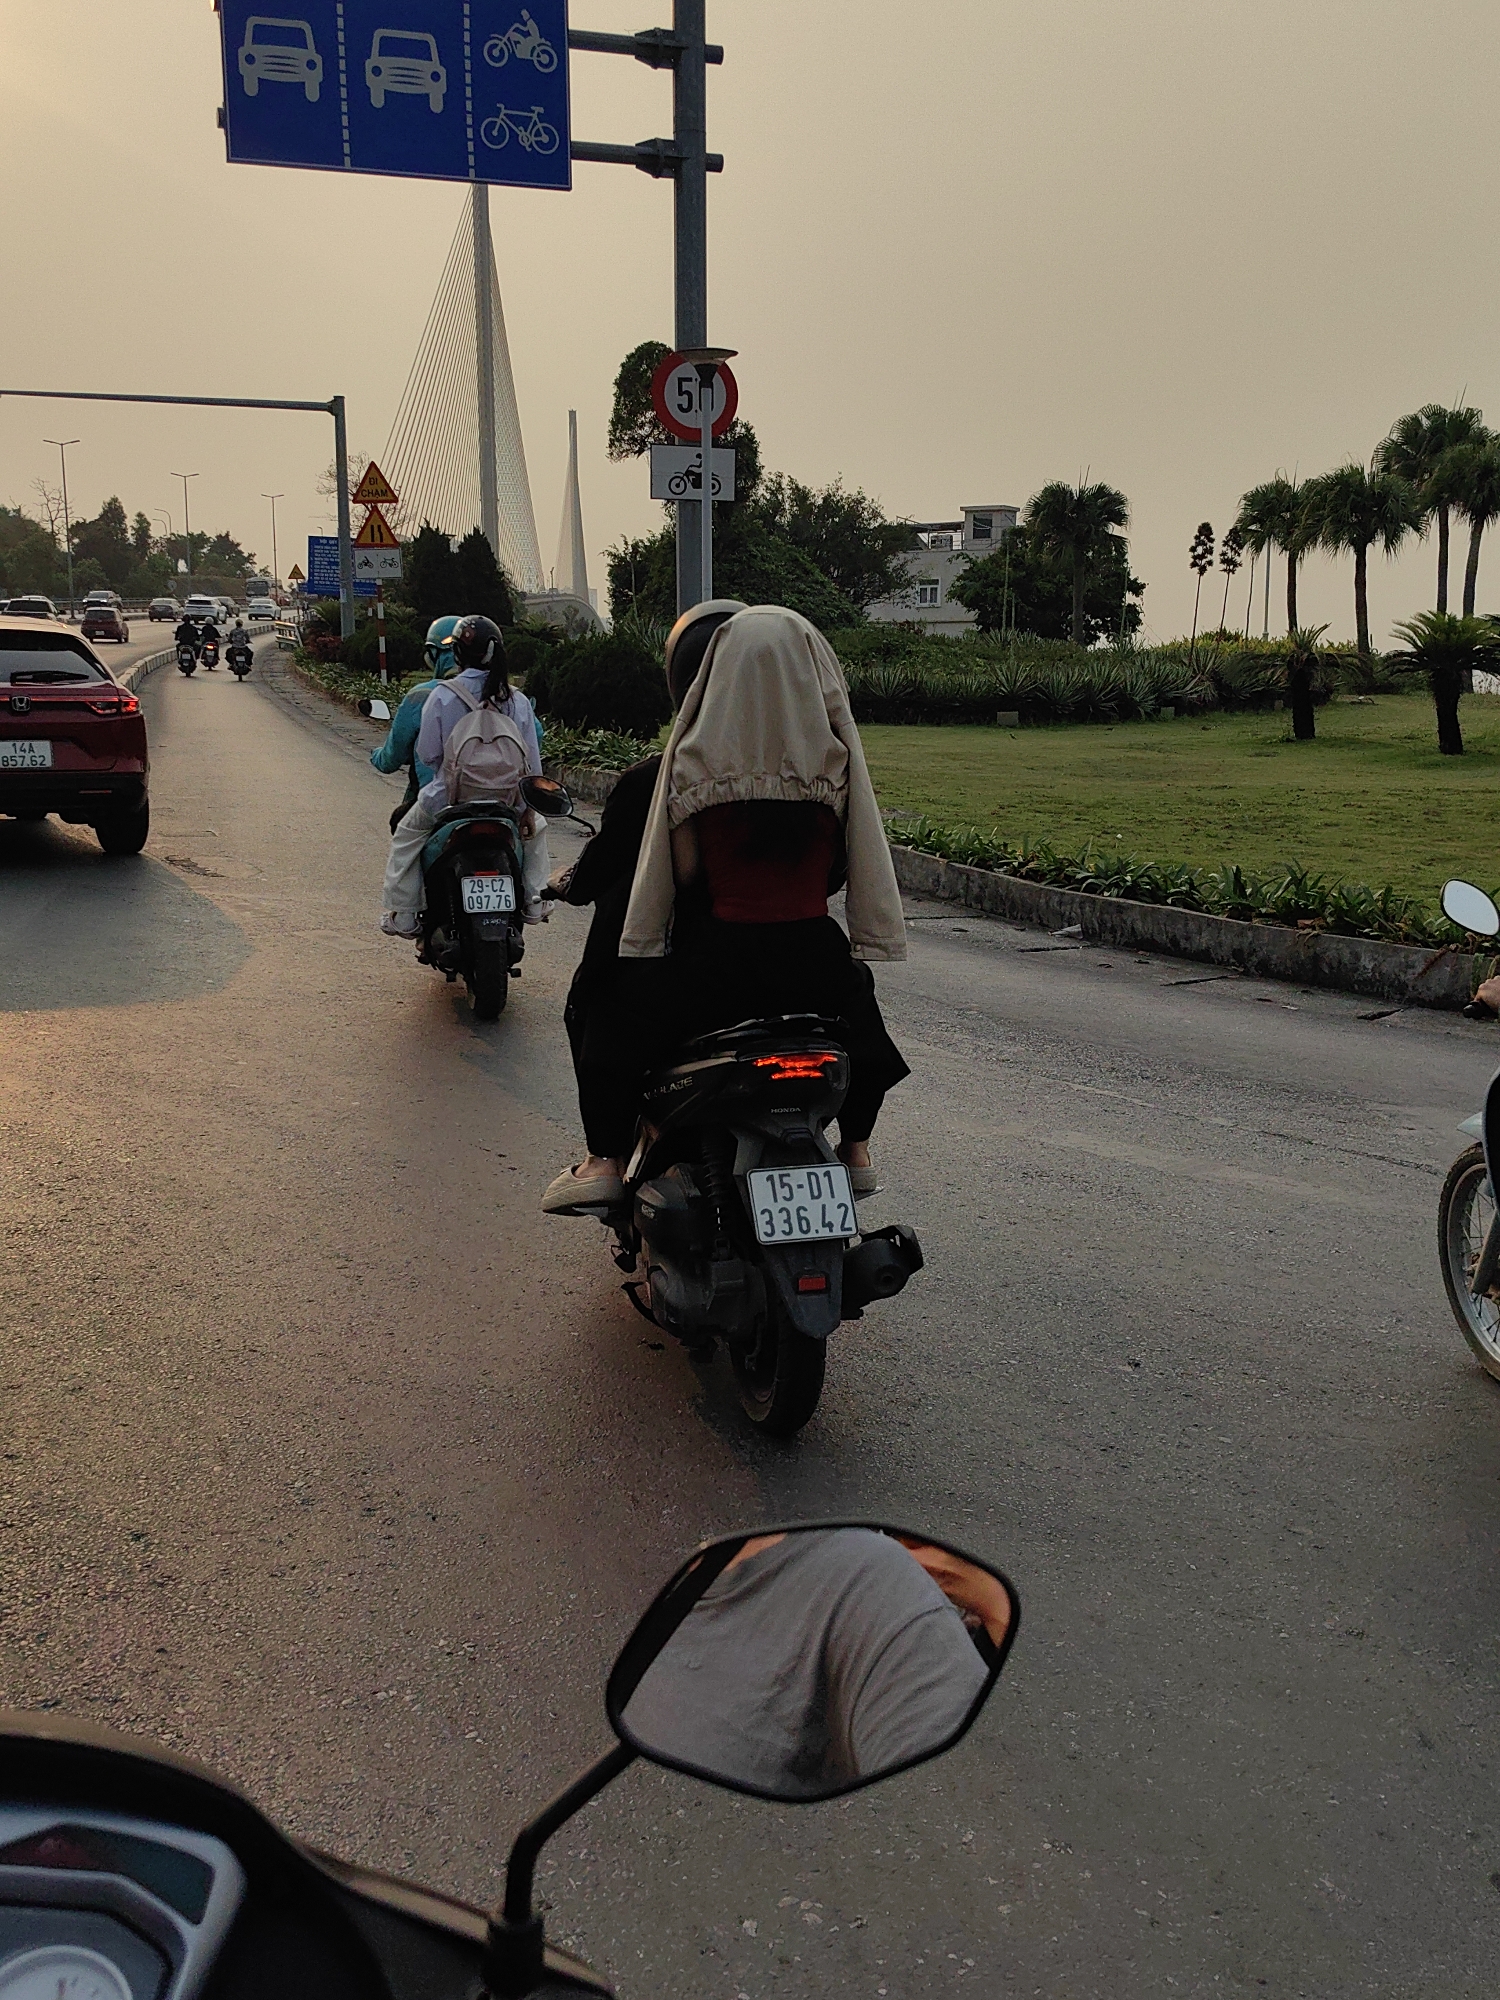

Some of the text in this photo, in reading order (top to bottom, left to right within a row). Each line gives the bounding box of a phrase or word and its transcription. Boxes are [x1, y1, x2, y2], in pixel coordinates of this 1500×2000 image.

[360, 489, 389, 499] CHẠM
[11, 742, 35, 755] 14A
[1, 755, 46, 767] 857.62
[469, 878, 506, 894] 29-C2
[467, 894, 512, 910] 097.76
[765, 1170, 836, 1204] 15-D1
[760, 1202, 853, 1238] 336.42
